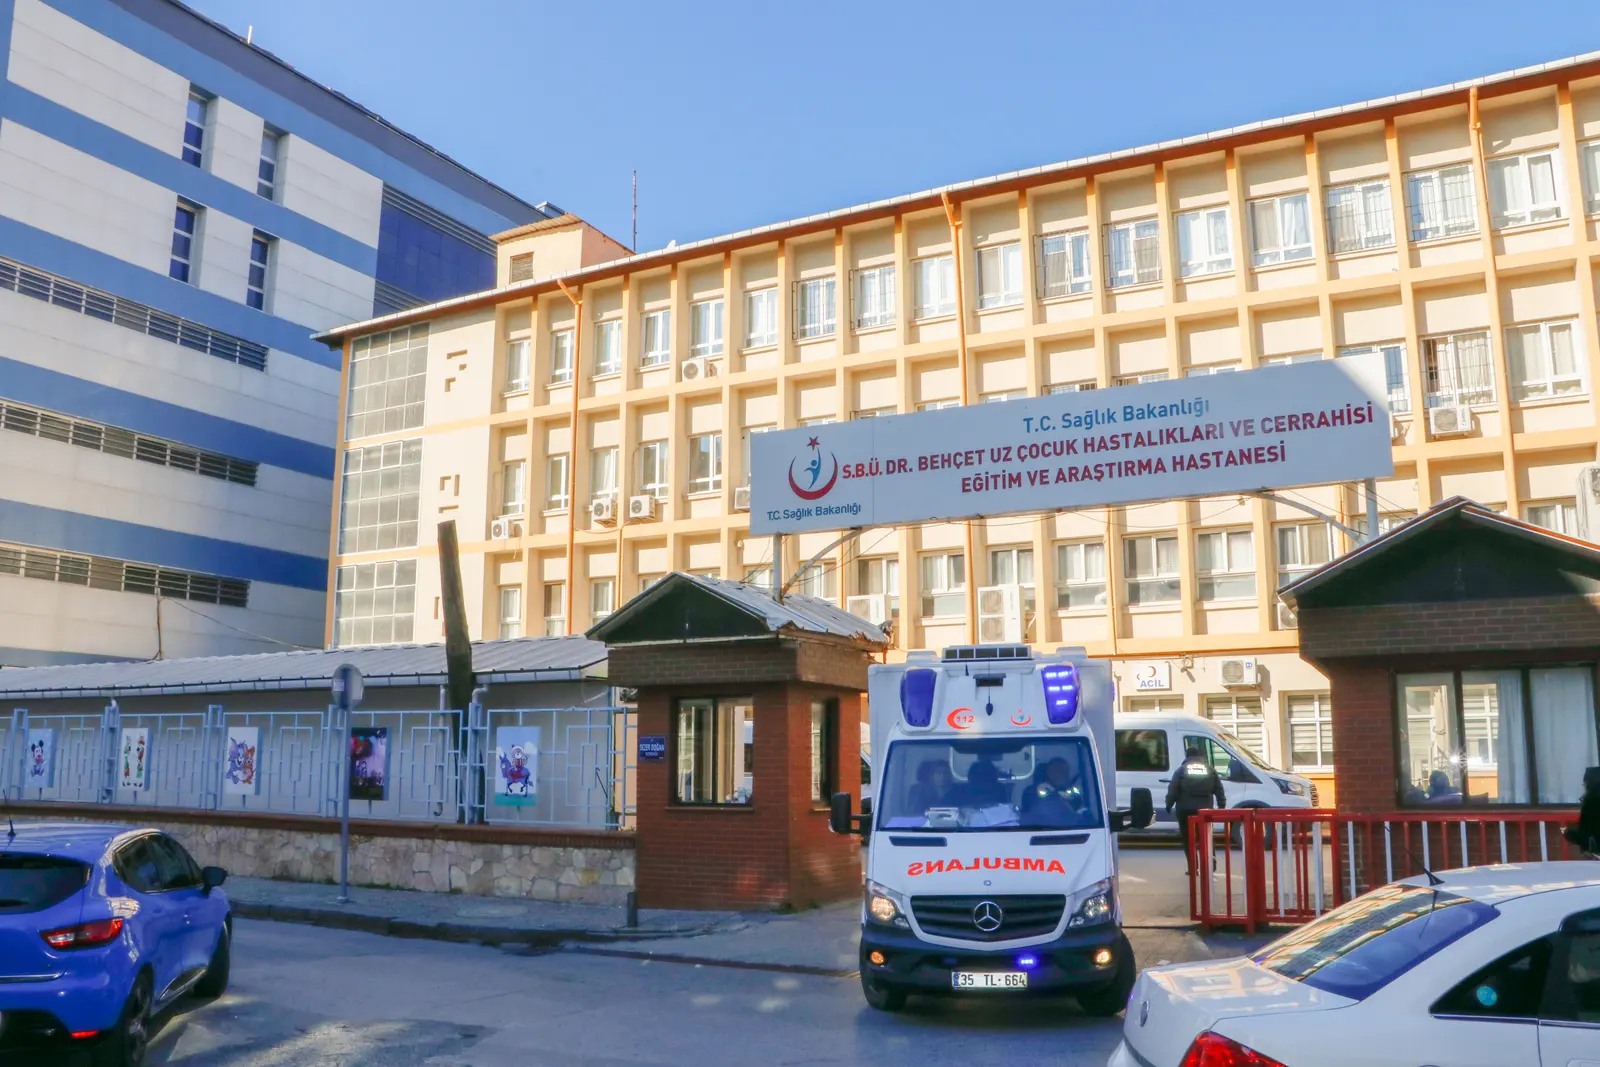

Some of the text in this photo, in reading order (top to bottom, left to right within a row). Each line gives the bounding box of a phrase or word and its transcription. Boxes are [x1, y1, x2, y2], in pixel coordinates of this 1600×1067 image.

[1023, 396, 1210, 434] T.C. Sağlık Bakanlığı
[842, 401, 1374, 479] S.B.Ü. DR. BEHÇET UZ ÇOCUK HASTALIKLARI VE CERRAHİSİ
[961, 440, 1287, 493] EĞİTİM VE ARAŞTIRMA HASTANESİ
[767, 502, 862, 521] T.C. Sağlık Bakanlığı
[1140, 679, 1165, 688] ACİL
[956, 715, 975, 723] 112
[960, 974, 974, 986] 35
[1004, 974, 1025, 987] 664
